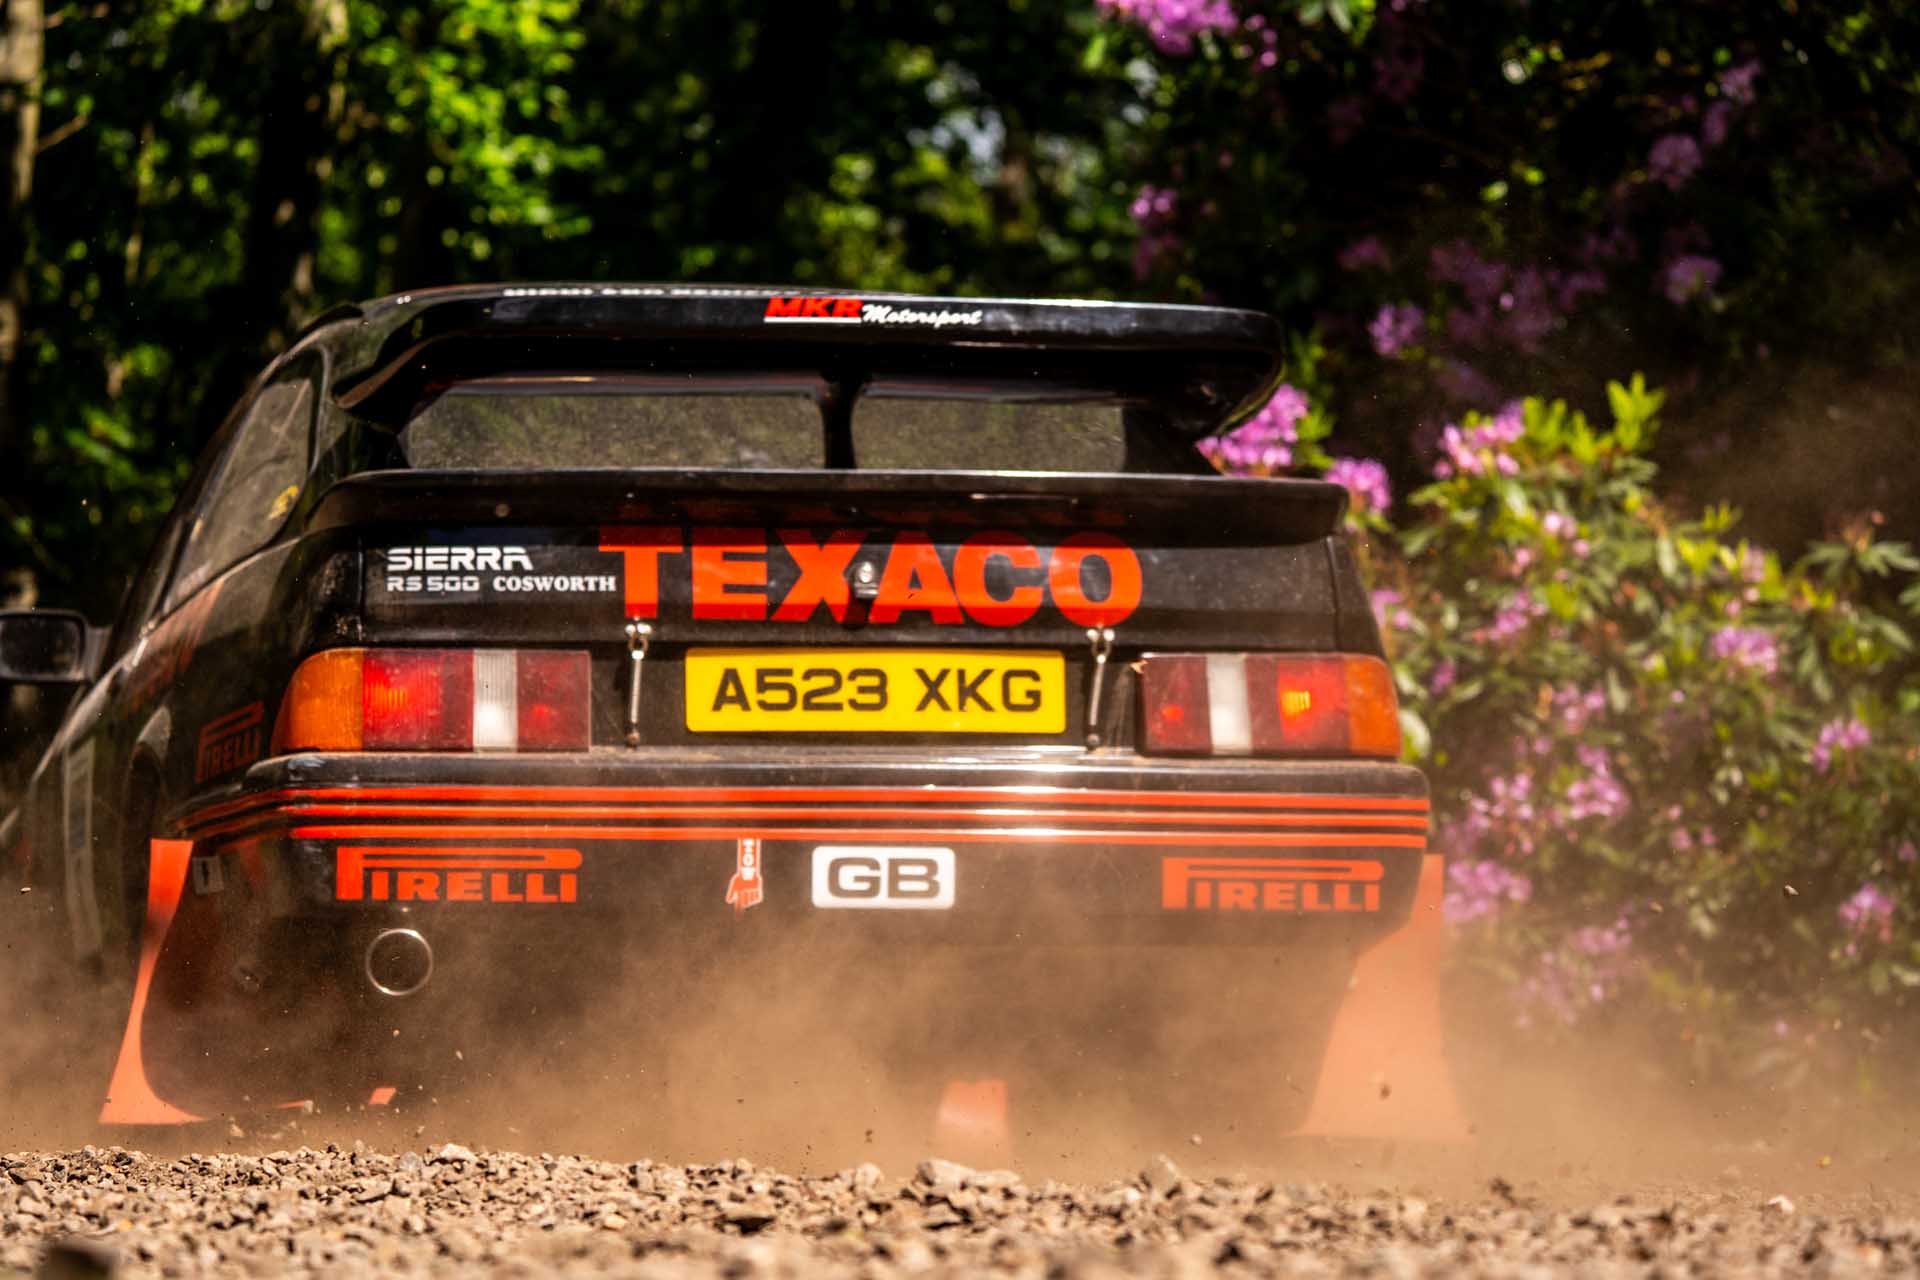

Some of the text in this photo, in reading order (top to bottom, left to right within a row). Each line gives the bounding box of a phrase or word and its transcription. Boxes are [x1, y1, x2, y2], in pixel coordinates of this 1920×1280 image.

[764, 297, 982, 328] MKR Motorsport
[387, 576, 616, 592] RS 500 COSWORTH
[598, 526, 1143, 627] TEXACO
[711, 668, 1042, 712] A523 XKG
[336, 846, 583, 903] PIRELLI
[827, 857, 941, 899] GB
[1161, 857, 1384, 912] PIRELLI
